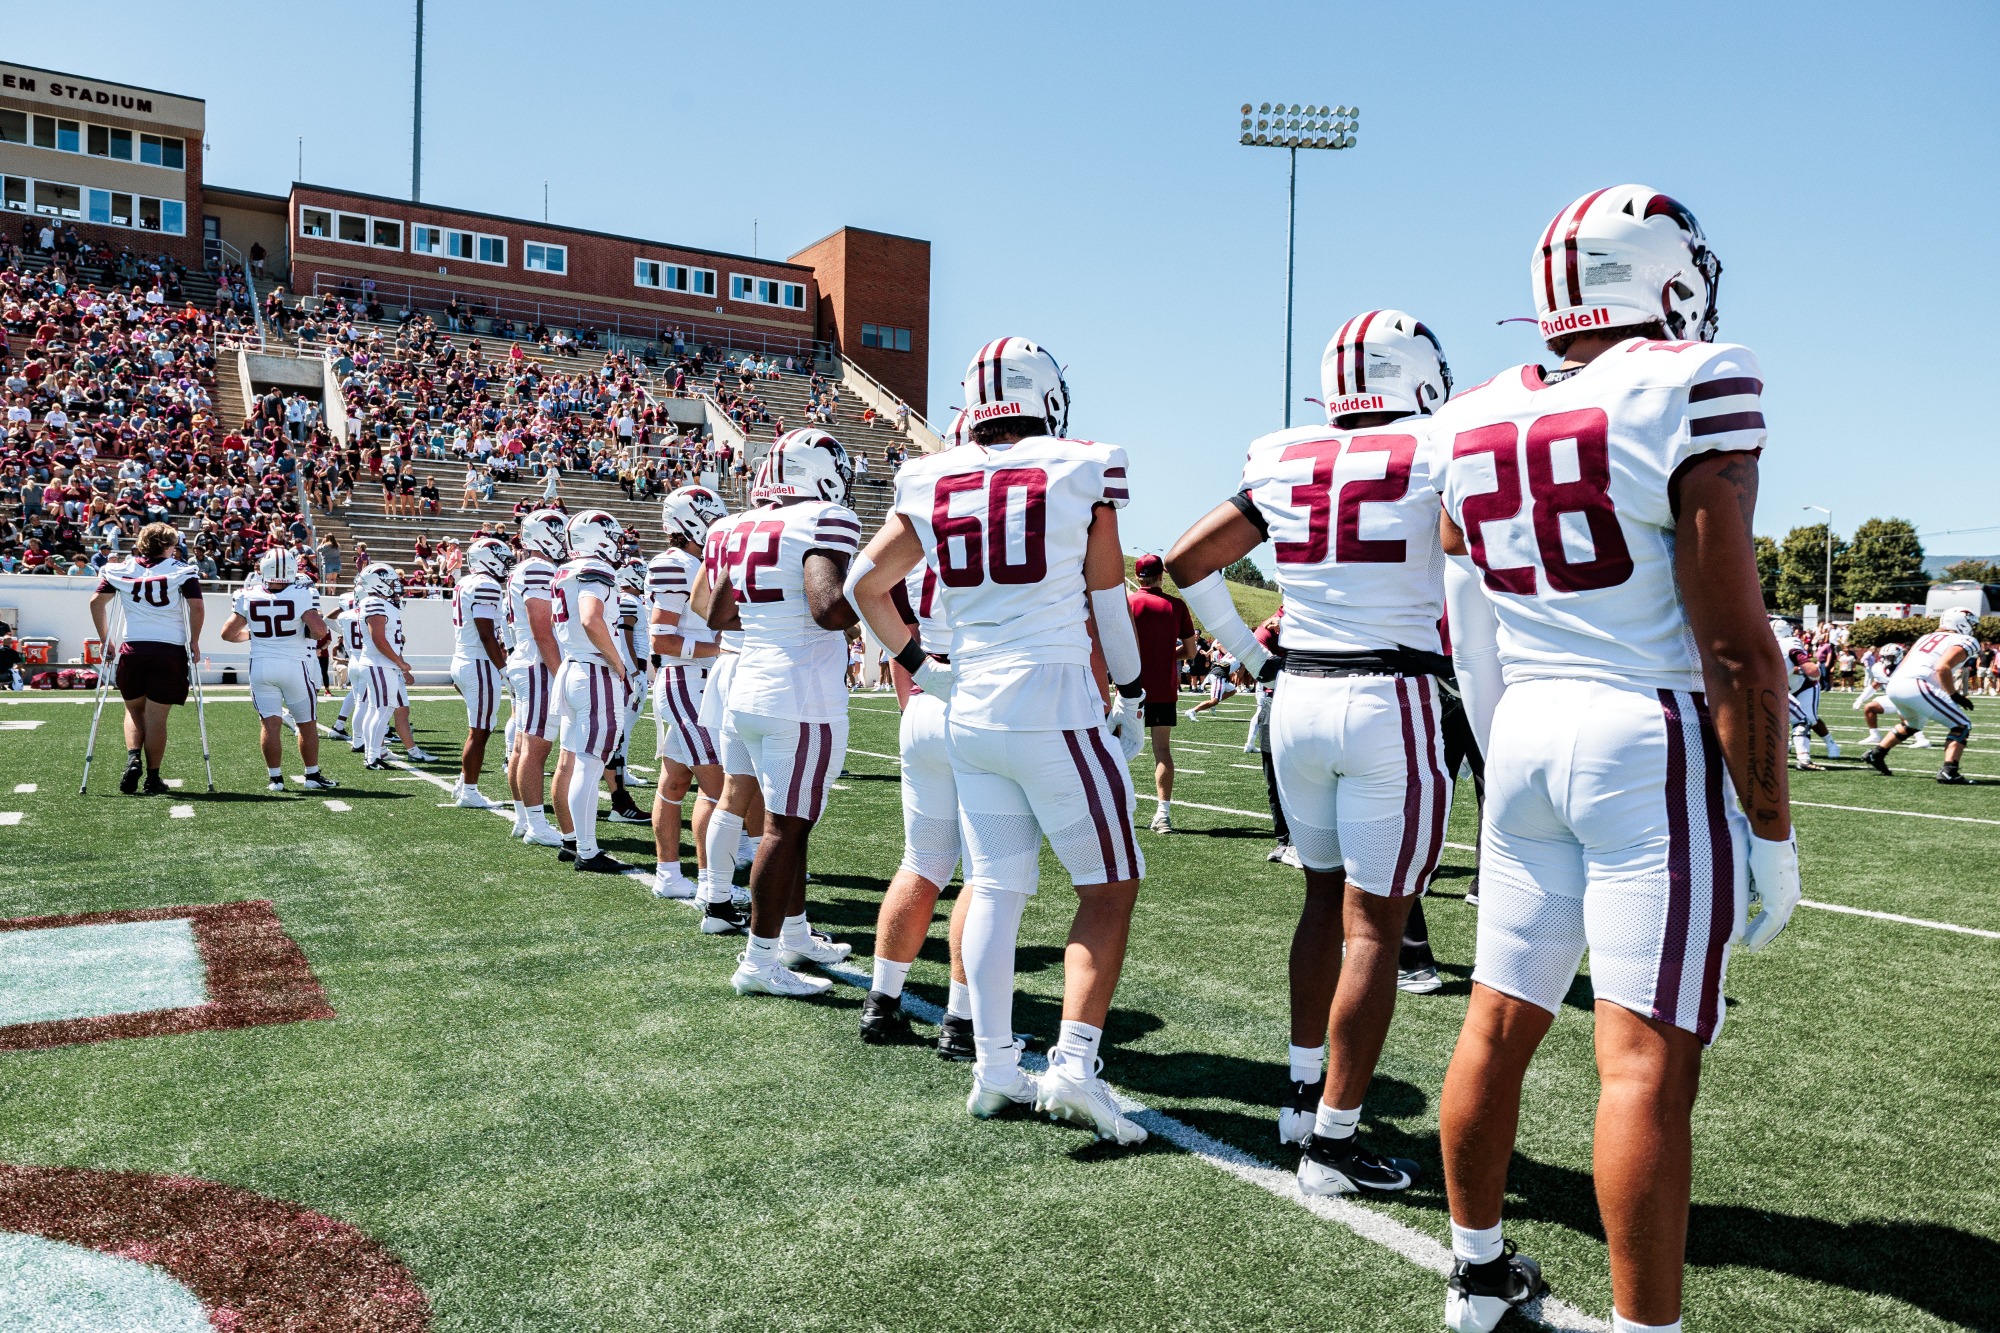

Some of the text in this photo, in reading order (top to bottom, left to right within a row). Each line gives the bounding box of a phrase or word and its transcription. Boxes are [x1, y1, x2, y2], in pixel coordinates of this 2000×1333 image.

[50, 83, 153, 113] STADIUM
[1541, 308, 1610, 336] Riddell
[974, 403, 1021, 421] Riddell
[1330, 396, 1384, 414] Riddell
[1274, 434, 1418, 563] 32
[1452, 407, 1634, 596] 28
[931, 467, 1048, 587] 60
[727, 521, 785, 603] 22
[249, 600, 297, 638] 52
